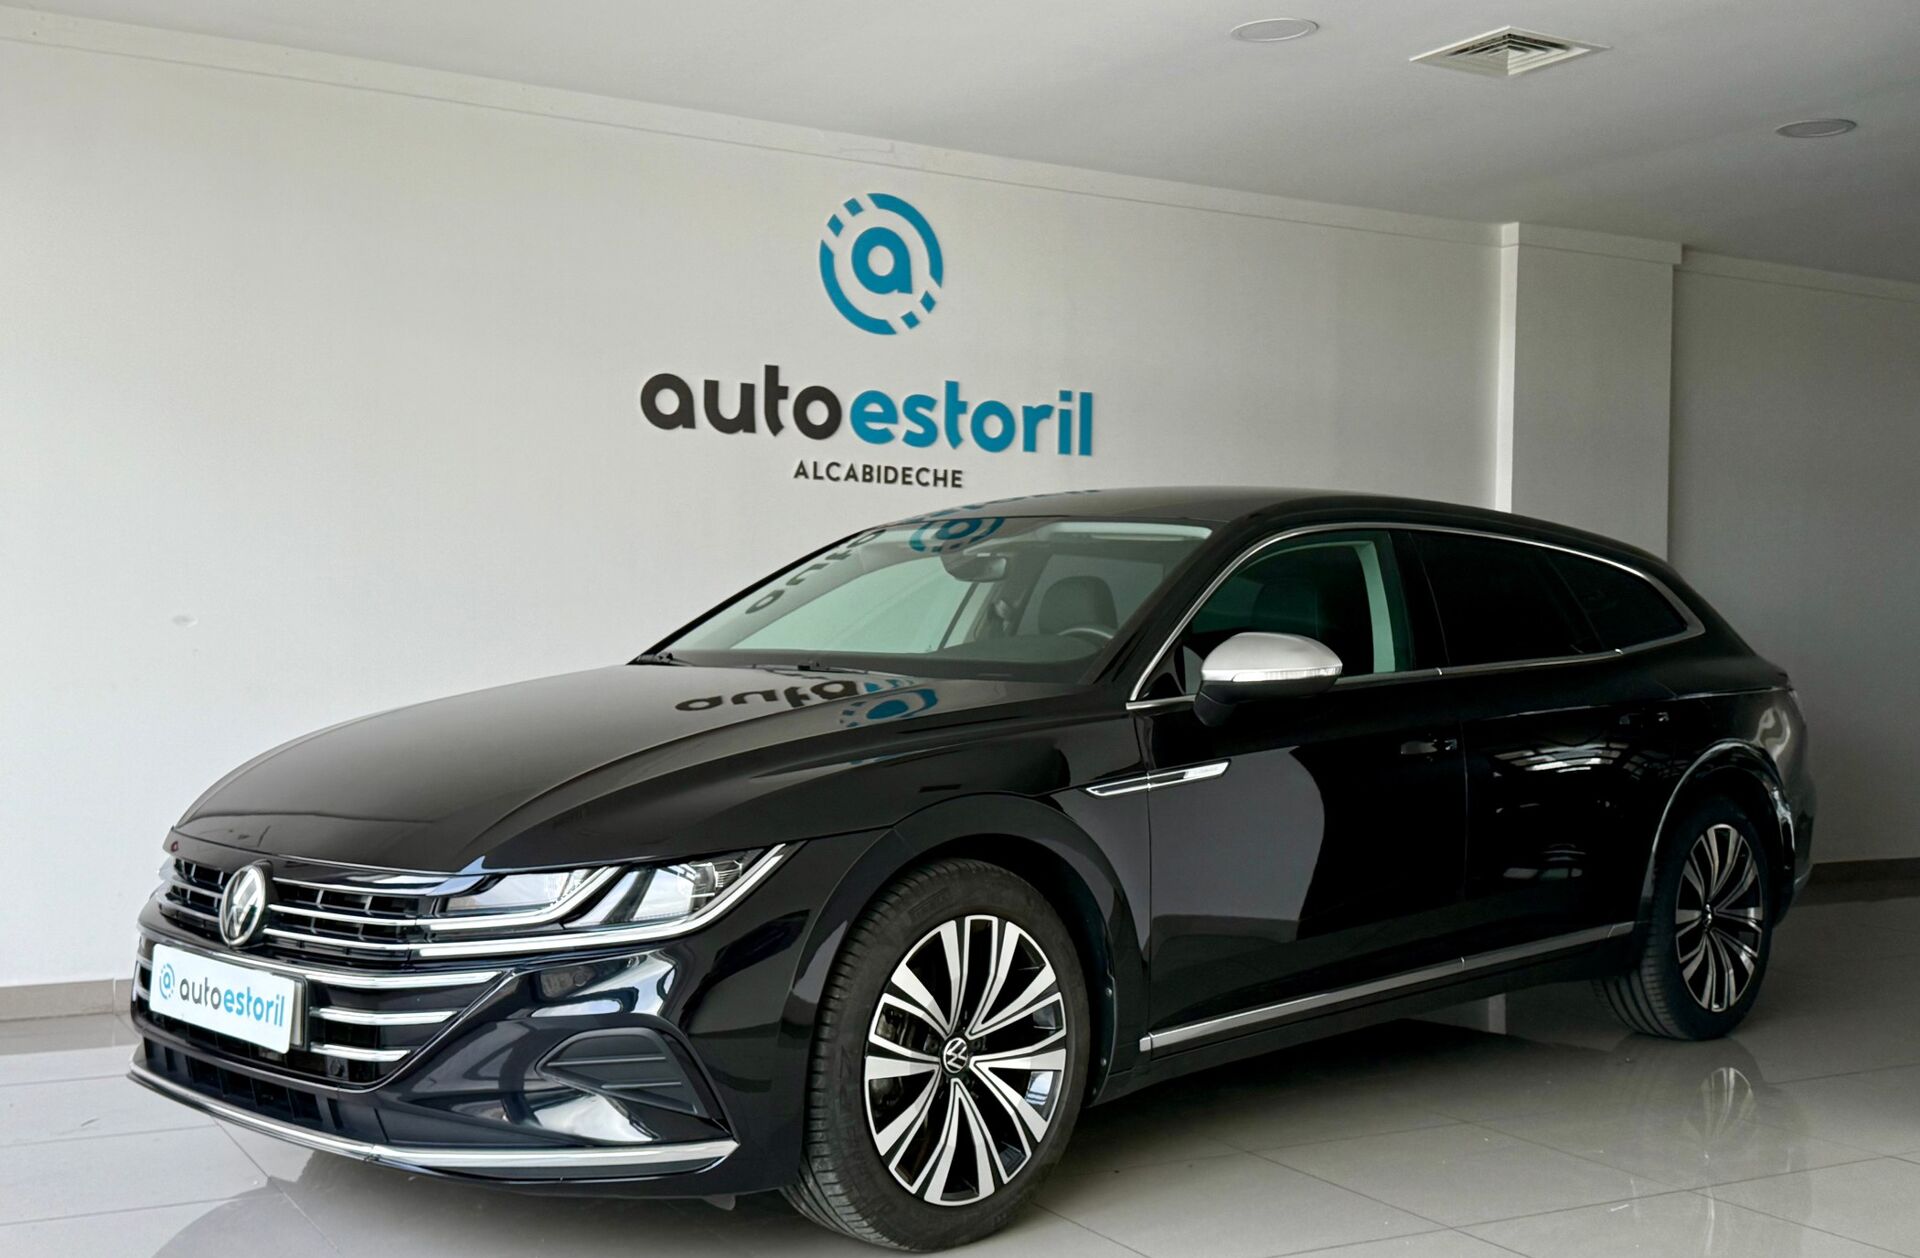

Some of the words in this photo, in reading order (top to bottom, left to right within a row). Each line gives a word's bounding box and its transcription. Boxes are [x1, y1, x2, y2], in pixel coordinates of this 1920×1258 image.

[852, 226, 912, 294] a
[640, 364, 1093, 457] autoestoril
[793, 460, 963, 488] ALCABIDECHE
[179, 977, 285, 1026] autoestoril
